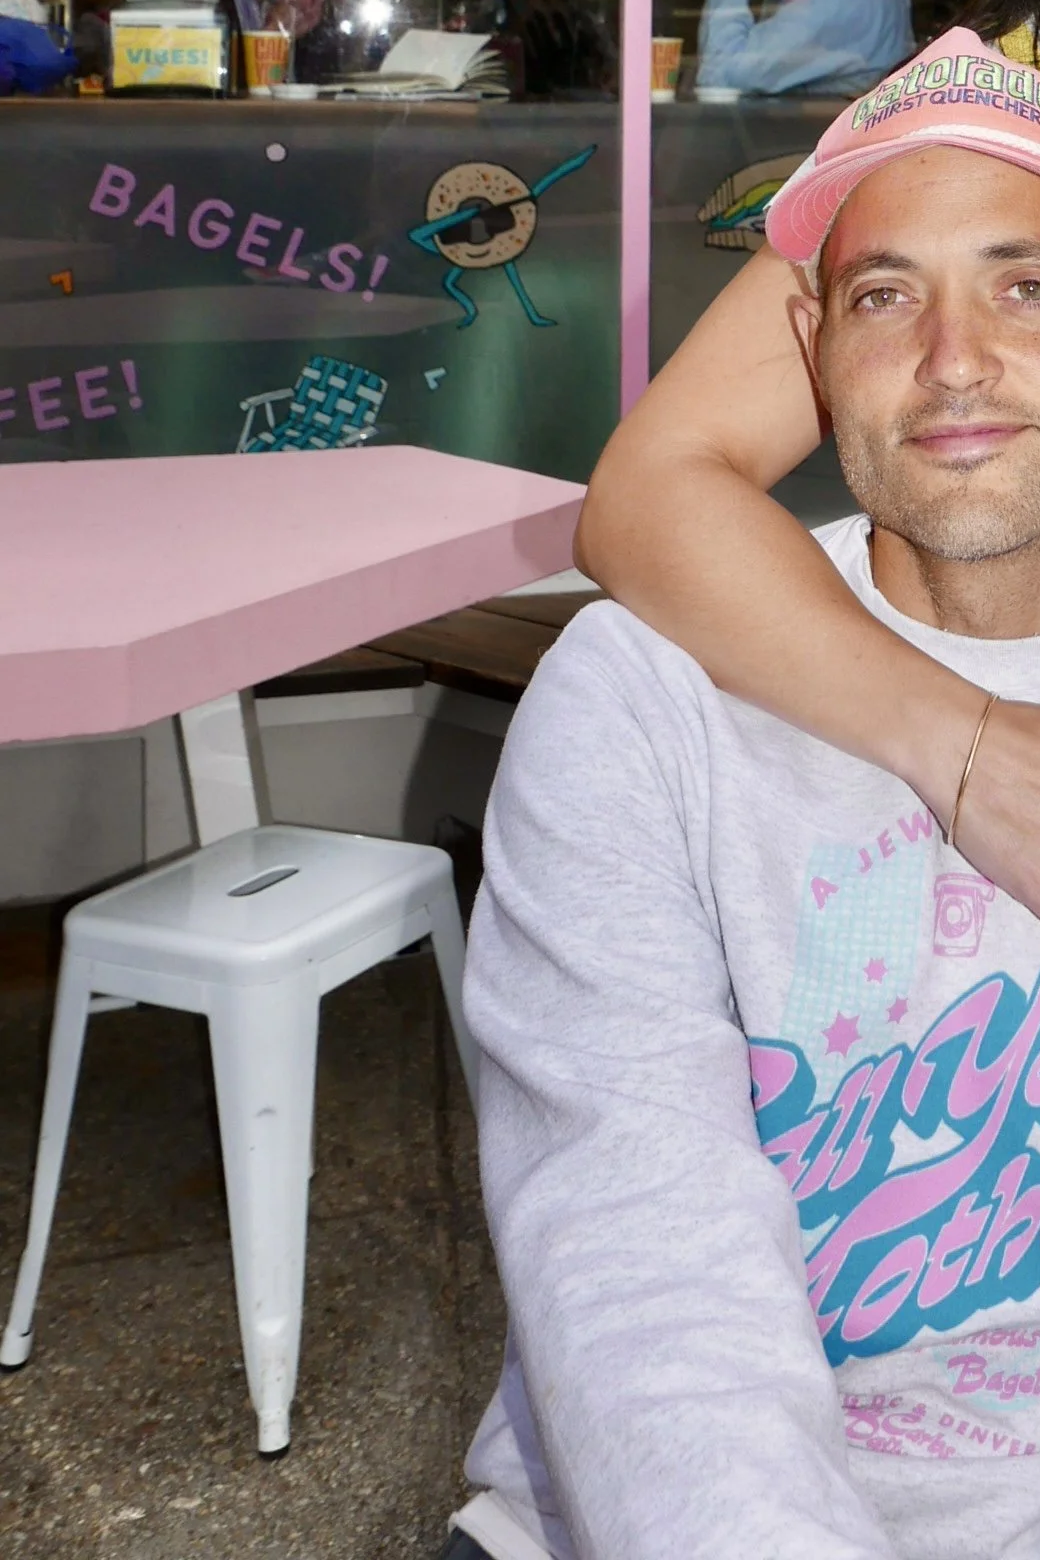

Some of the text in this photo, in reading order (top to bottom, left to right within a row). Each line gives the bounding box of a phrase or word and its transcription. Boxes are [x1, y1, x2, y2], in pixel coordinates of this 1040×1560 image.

[126, 48, 210, 66] VIBES!
[864, 91, 929, 132] THIRST
[89, 164, 391, 302] BAGELS!
[810, 876, 840, 910] A
